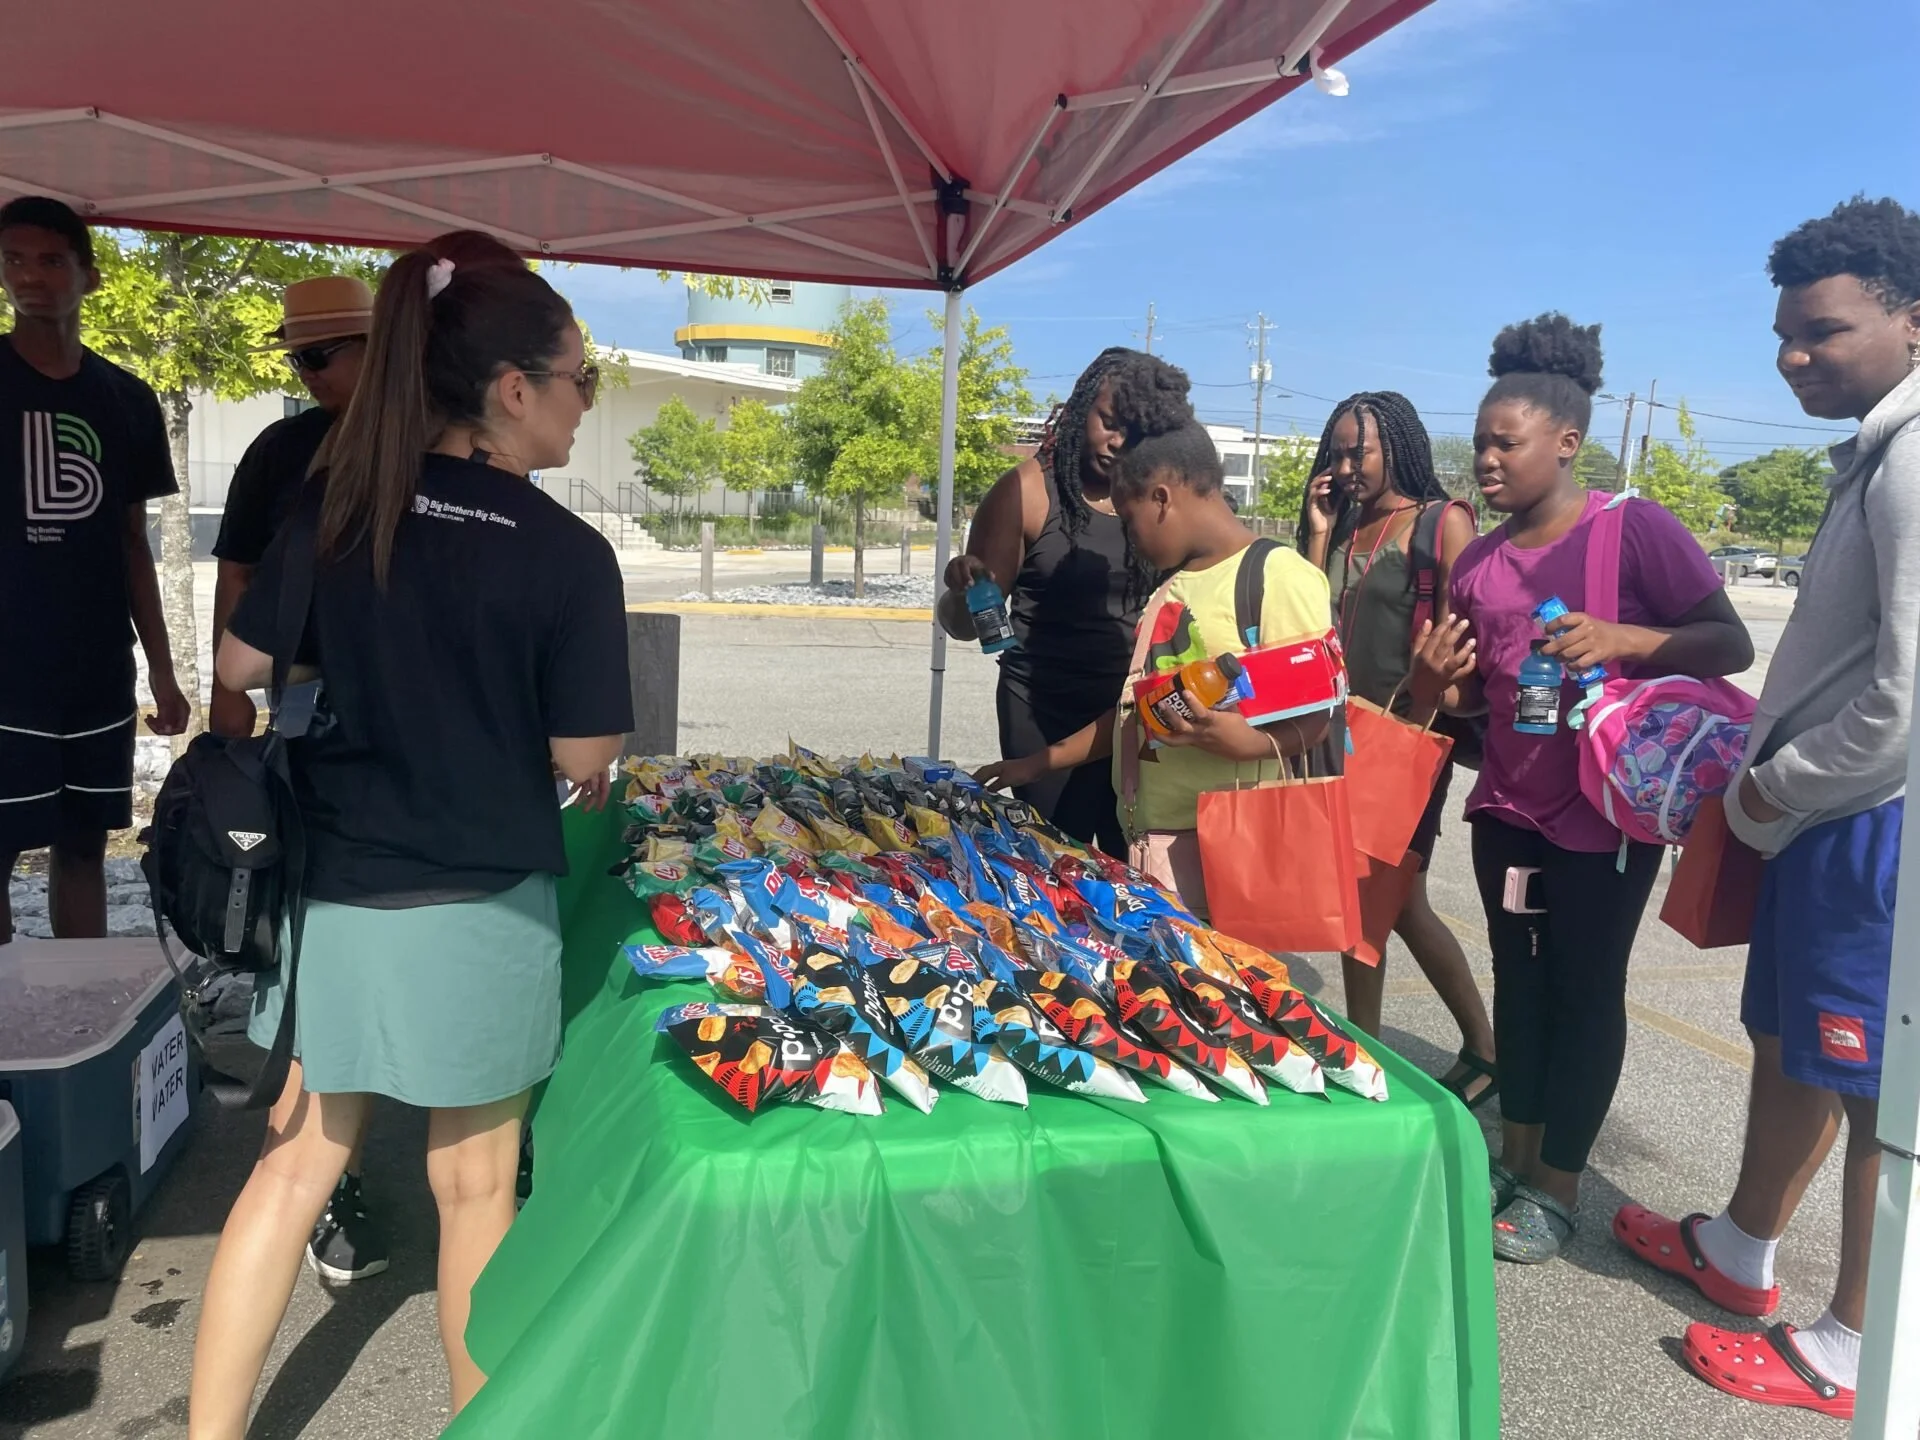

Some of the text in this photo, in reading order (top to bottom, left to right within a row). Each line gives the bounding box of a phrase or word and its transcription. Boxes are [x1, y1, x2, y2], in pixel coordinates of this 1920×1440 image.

[442, 502, 475, 517] Brothers
[475, 509, 489, 521] Big
[151, 1031, 184, 1082] WATER
[152, 1068, 184, 1122] WATER
